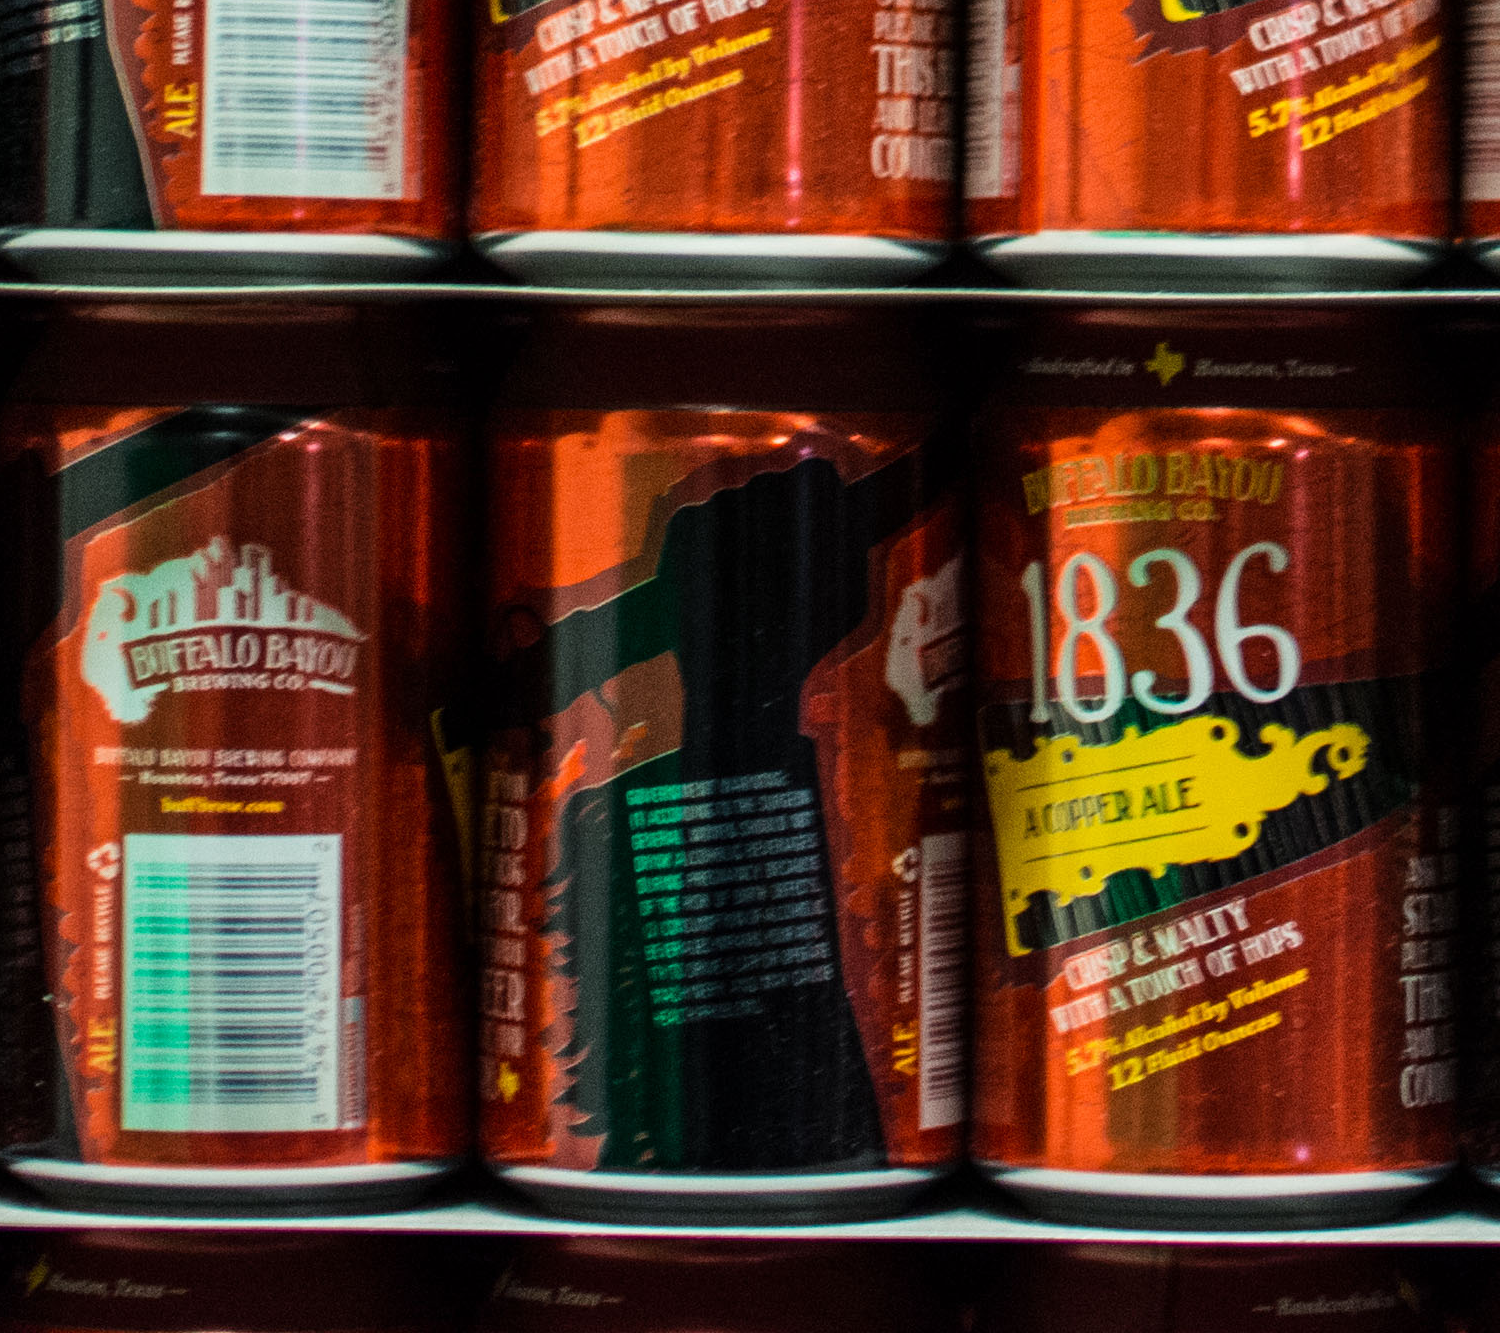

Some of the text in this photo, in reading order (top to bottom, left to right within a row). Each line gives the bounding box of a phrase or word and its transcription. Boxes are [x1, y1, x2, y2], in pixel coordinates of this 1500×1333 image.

[1167, 453, 1283, 502] BAYOU
[131, 635, 353, 677] BUFFALO BAYOU
[1022, 541, 1301, 725] 1836
[1046, 777, 1198, 832] COPPER ALE
